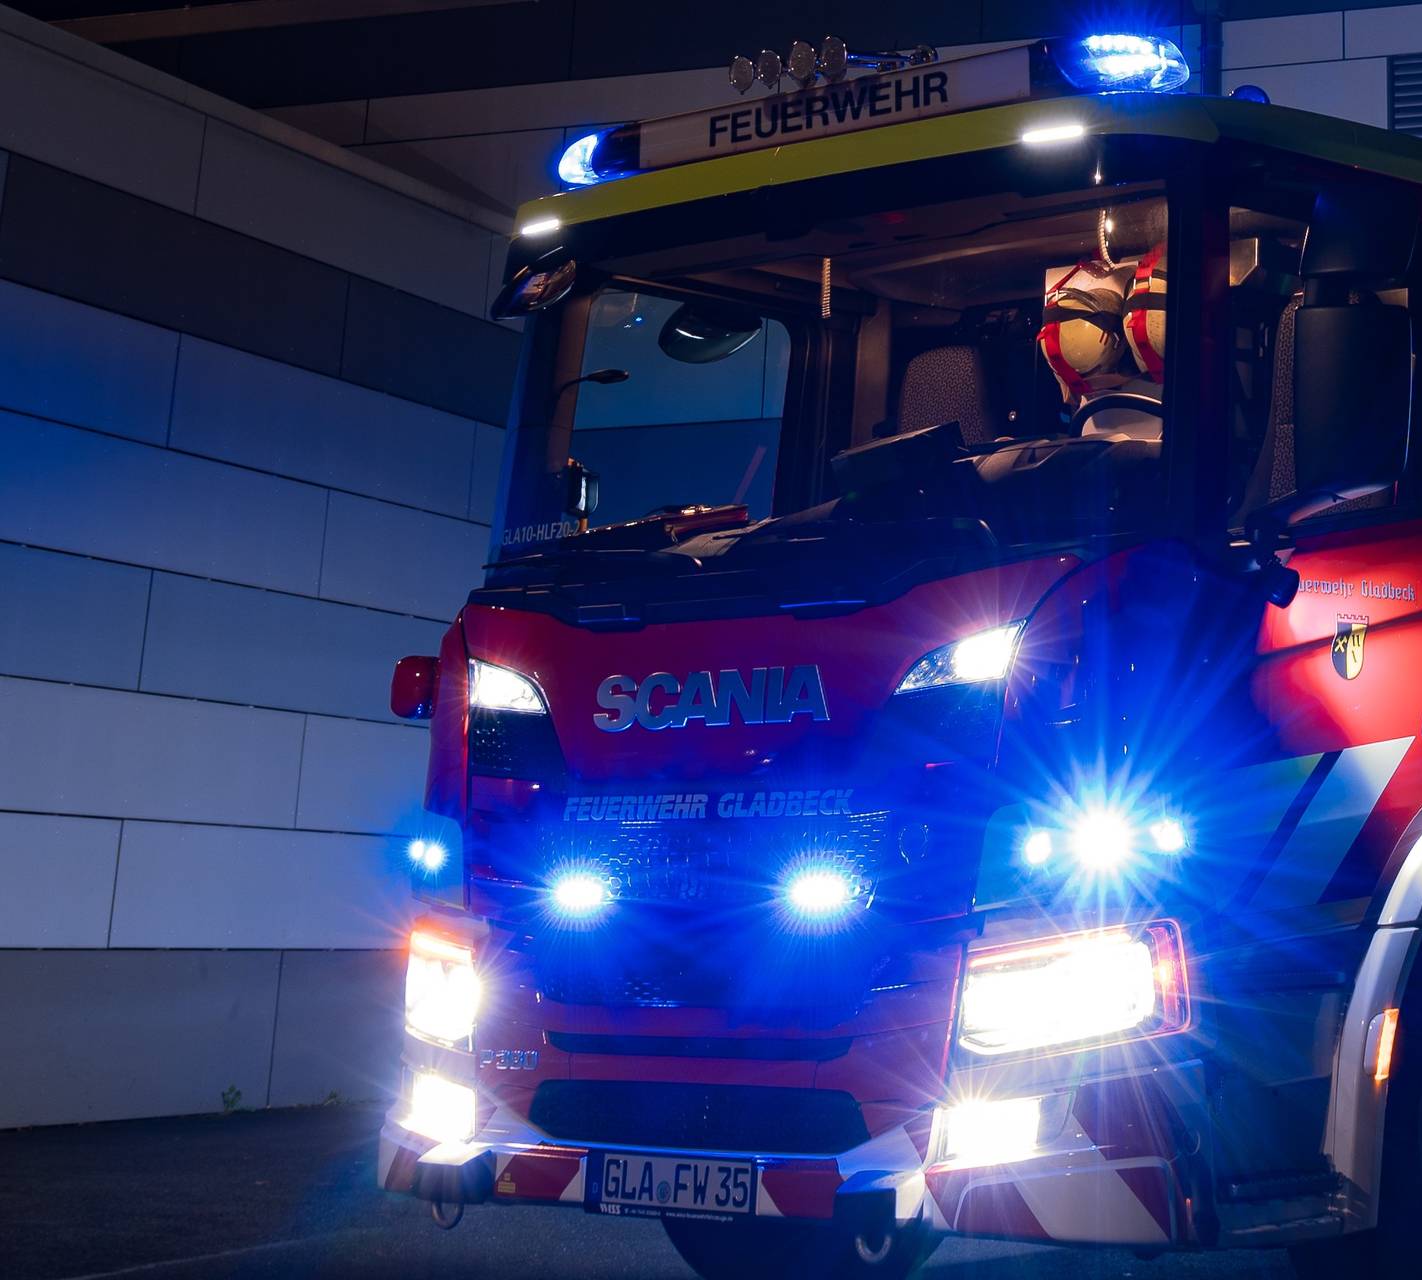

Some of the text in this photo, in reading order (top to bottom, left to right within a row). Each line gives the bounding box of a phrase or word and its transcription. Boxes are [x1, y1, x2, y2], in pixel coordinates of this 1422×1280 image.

[708, 70, 949, 148] FEUERWEHR
[502, 520, 580, 546] GLA10-HLF20-2
[1298, 578, 1415, 601] uerwehr Gladbeck
[593, 664, 830, 732] SCANIA
[563, 789, 854, 821] FEUERWEHR GLADBECK
[604, 1158, 750, 1208] GLA FW 35
